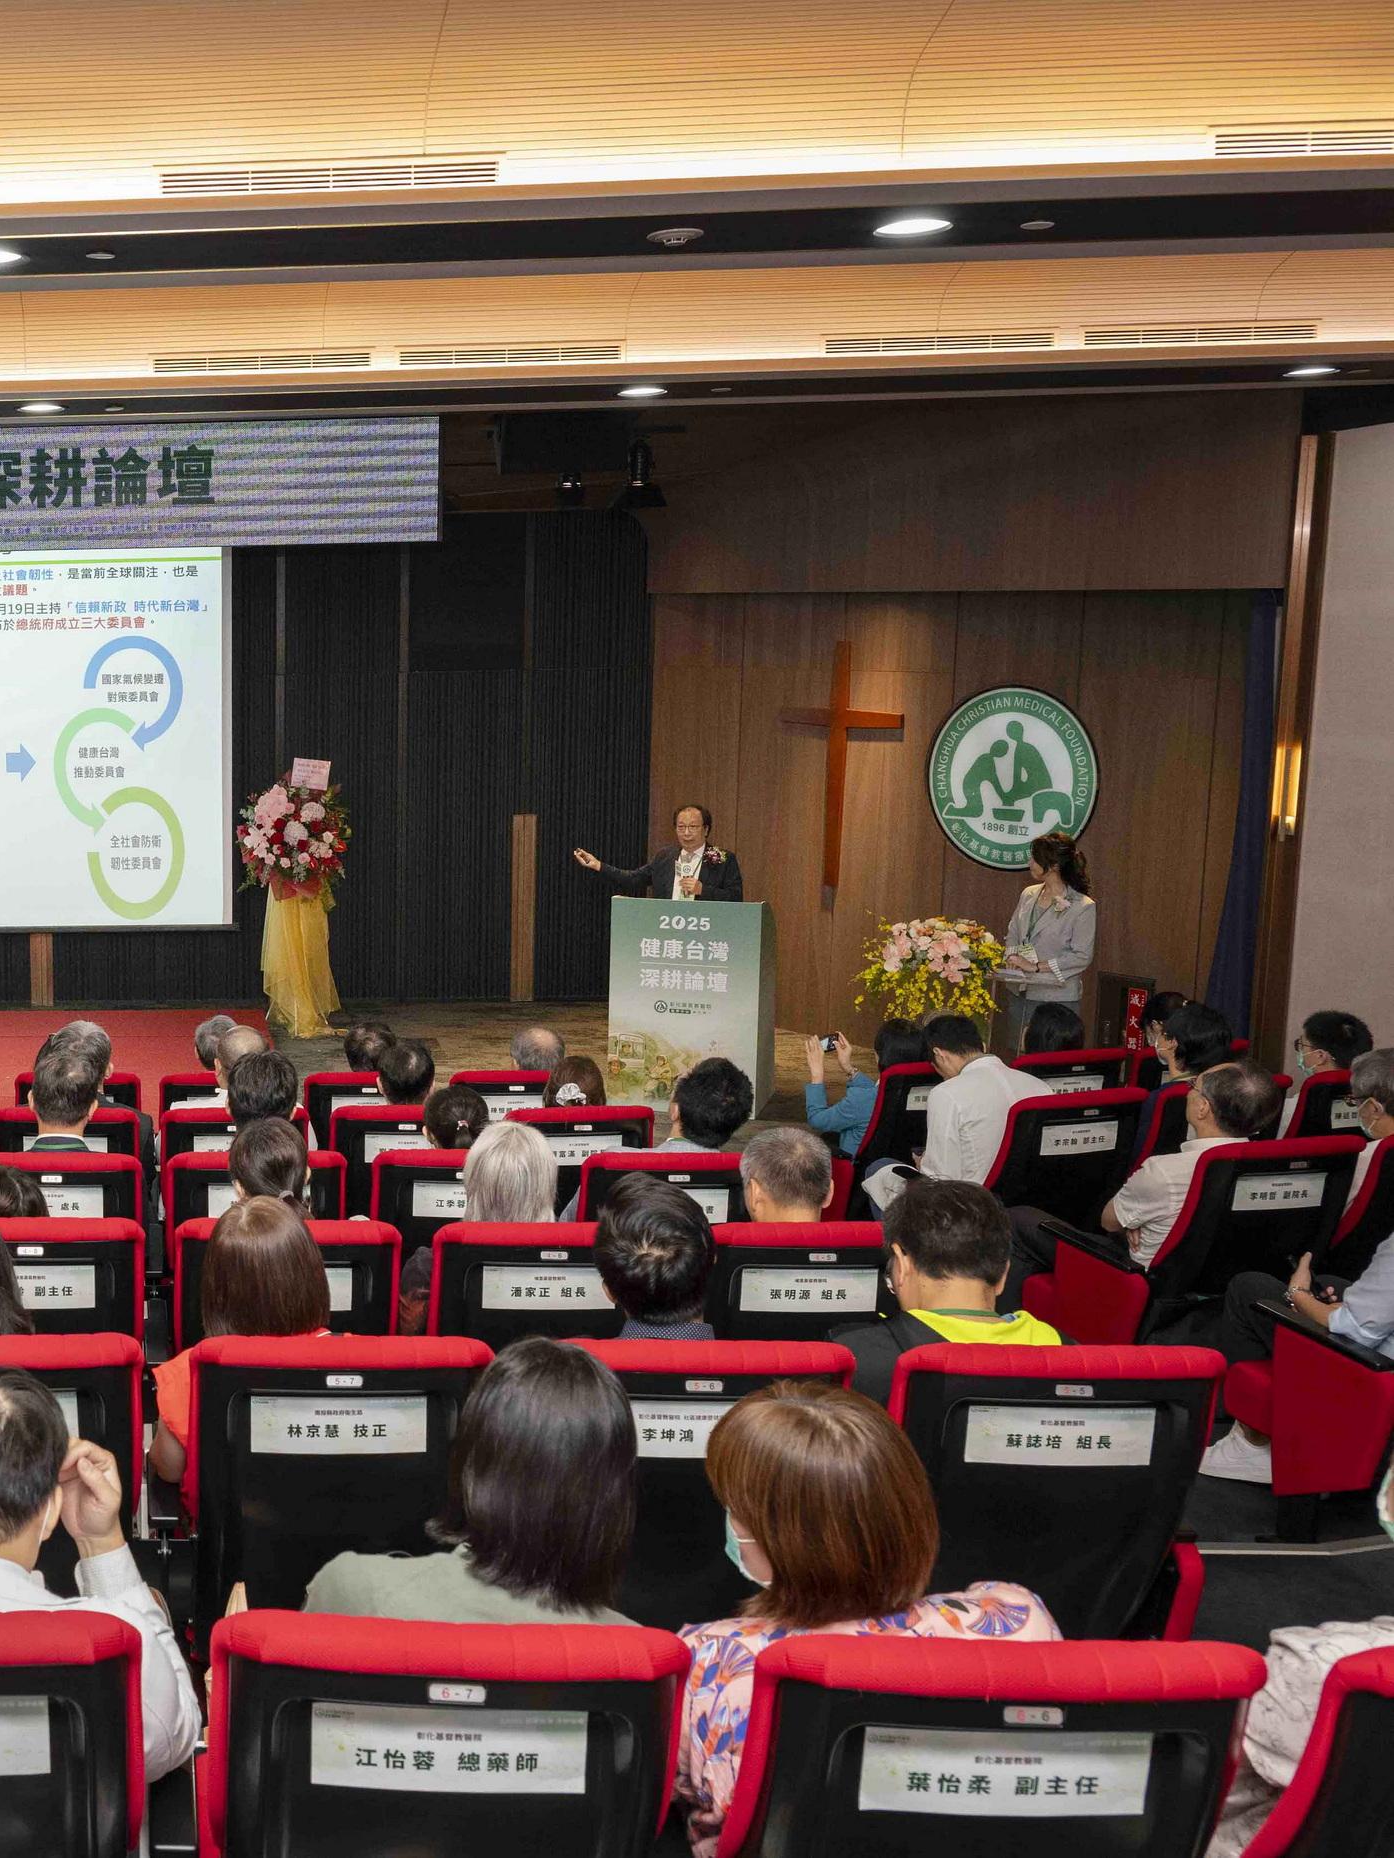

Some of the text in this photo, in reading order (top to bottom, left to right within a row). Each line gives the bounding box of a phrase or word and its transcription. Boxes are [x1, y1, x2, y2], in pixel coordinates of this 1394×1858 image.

[101, 673, 165, 687] 國家氣候變遷
[107, 690, 160, 704] 對策委員會
[78, 746, 120, 760] 健康台灣
[936, 696, 1090, 807] CHANGHUA CHRISTIAN MEDICAL FOUNDATION
[73, 765, 126, 780] 推動委員會
[982, 822, 1029, 837] 1896 創立
[110, 834, 162, 850] 全社會防衛
[110, 855, 162, 872] 韌性委員會
[659, 915, 711, 931] 2025
[640, 938, 729, 962] 健康台灣
[640, 968, 728, 993] 深耕論壇
[34, 1286, 73, 1297] 副主任
[510, 1286, 586, 1298] 潘家正 組長
[769, 1289, 847, 1300] 張明源 組長
[287, 1424, 388, 1438] 林京慧 技正
[642, 1428, 694, 1442] 李坤鴻
[1006, 1433, 1112, 1450] 蘇誌培 組長
[355, 1748, 539, 1773] 江怡蓉 總藥師
[907, 1772, 1099, 1796] 葉怡柔 副主任
